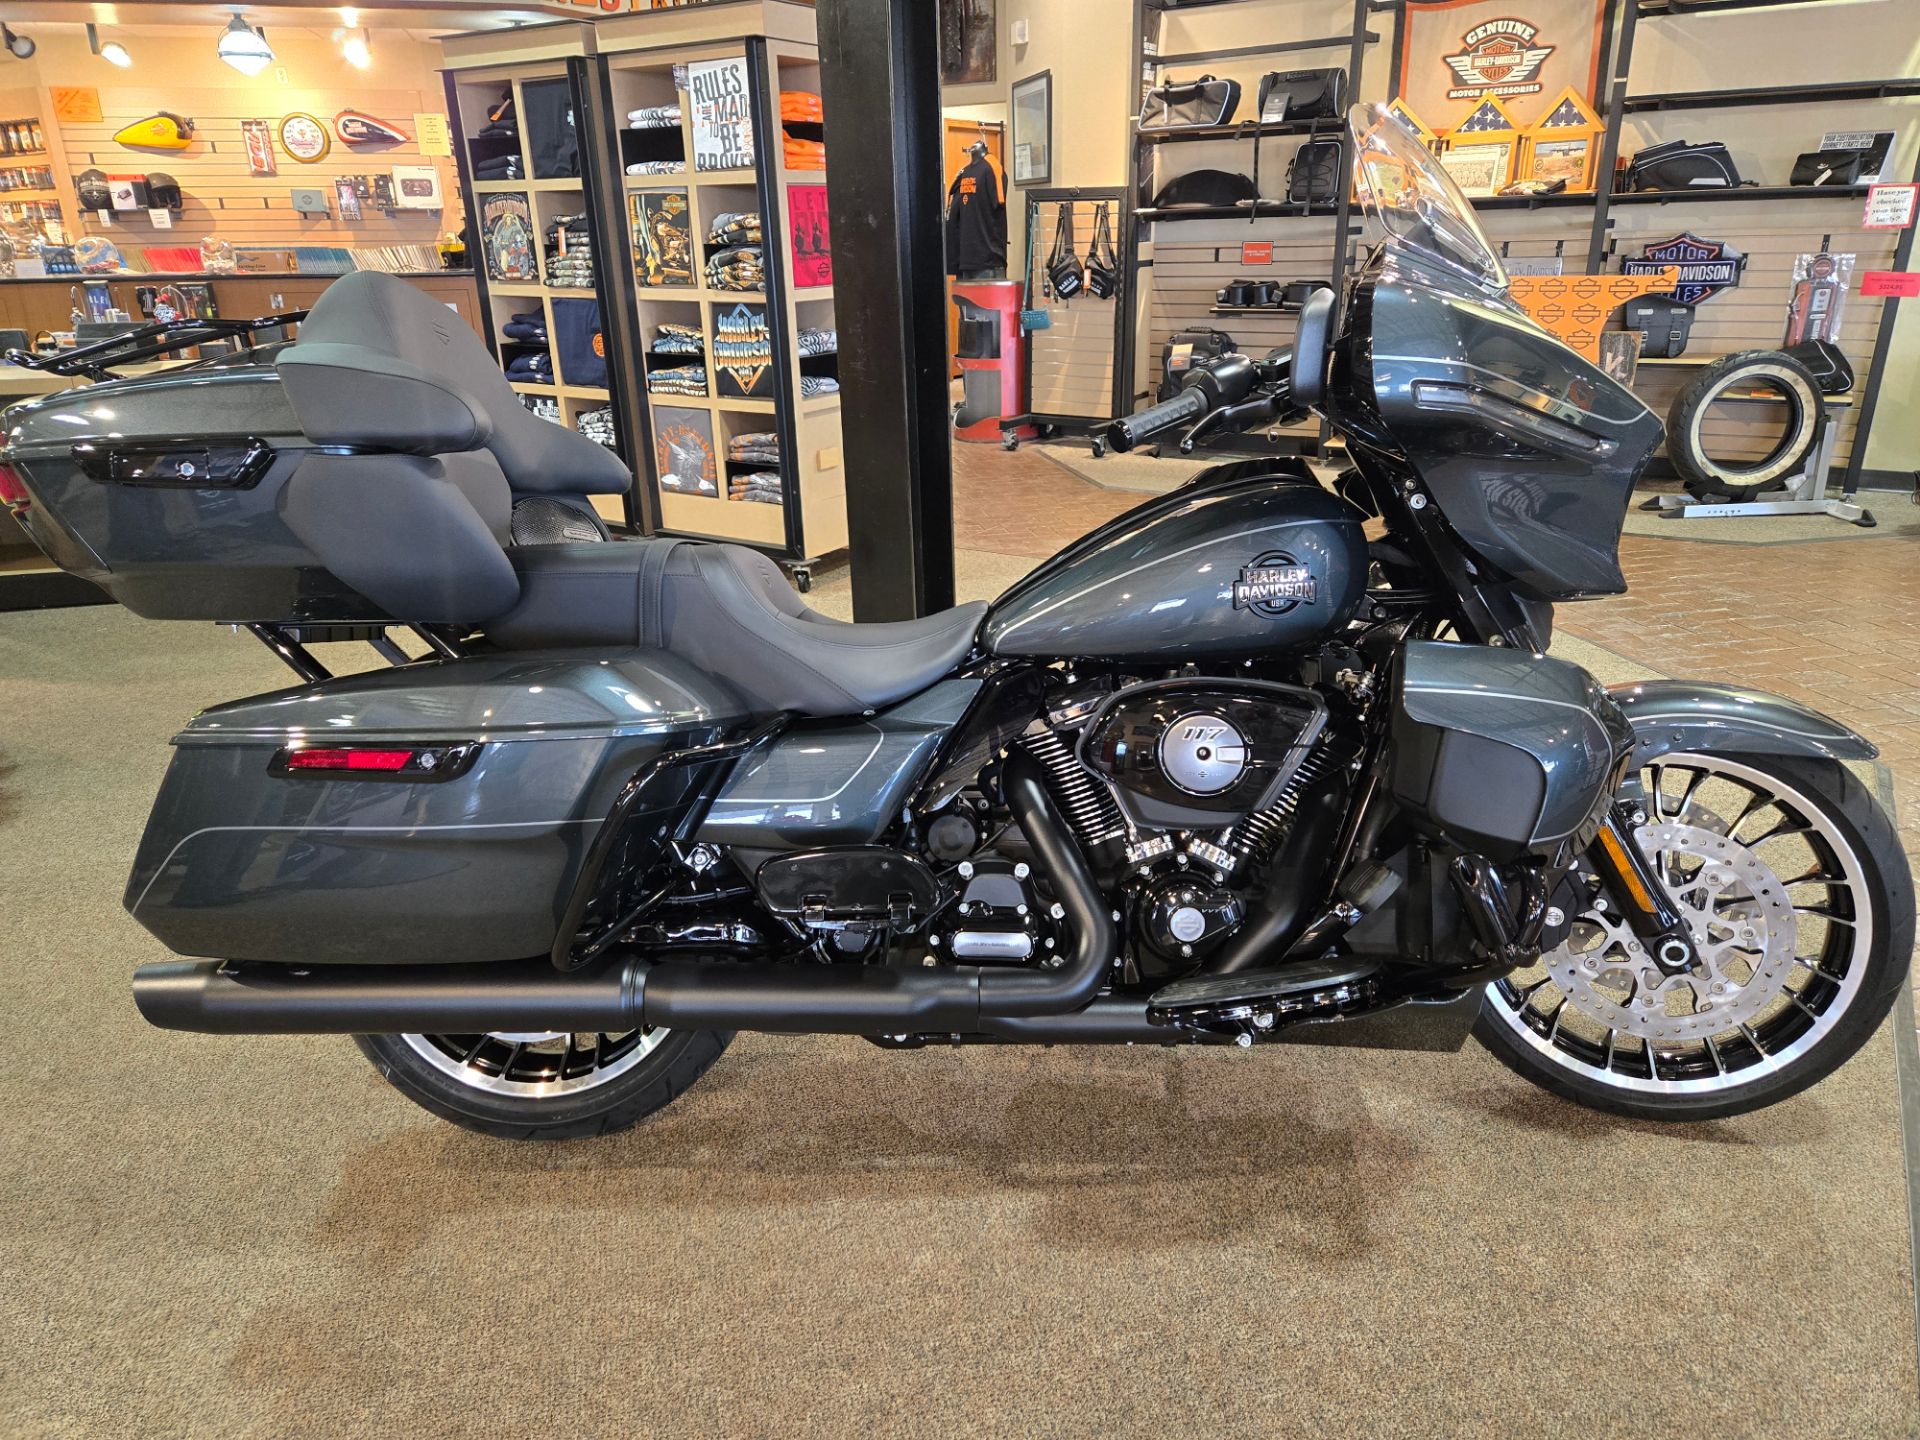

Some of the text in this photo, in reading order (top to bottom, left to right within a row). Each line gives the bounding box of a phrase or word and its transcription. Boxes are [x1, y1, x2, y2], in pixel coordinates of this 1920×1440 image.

[1466, 20, 1536, 45] GENUINE
[1485, 45, 1511, 54] MOTOR
[1482, 67, 1509, 78] CYCLES
[692, 64, 742, 105] RULES
[1449, 88, 1481, 98] MOTOR
[702, 105, 712, 120] ARE
[714, 94, 750, 122] MAD
[709, 121, 719, 138] TO
[720, 122, 742, 153] BE
[1655, 244, 1708, 260] MOTOR
[1238, 581, 1314, 602] DAVIDSON
[1271, 599, 1285, 607] USA
[1182, 726, 1228, 741] 117
